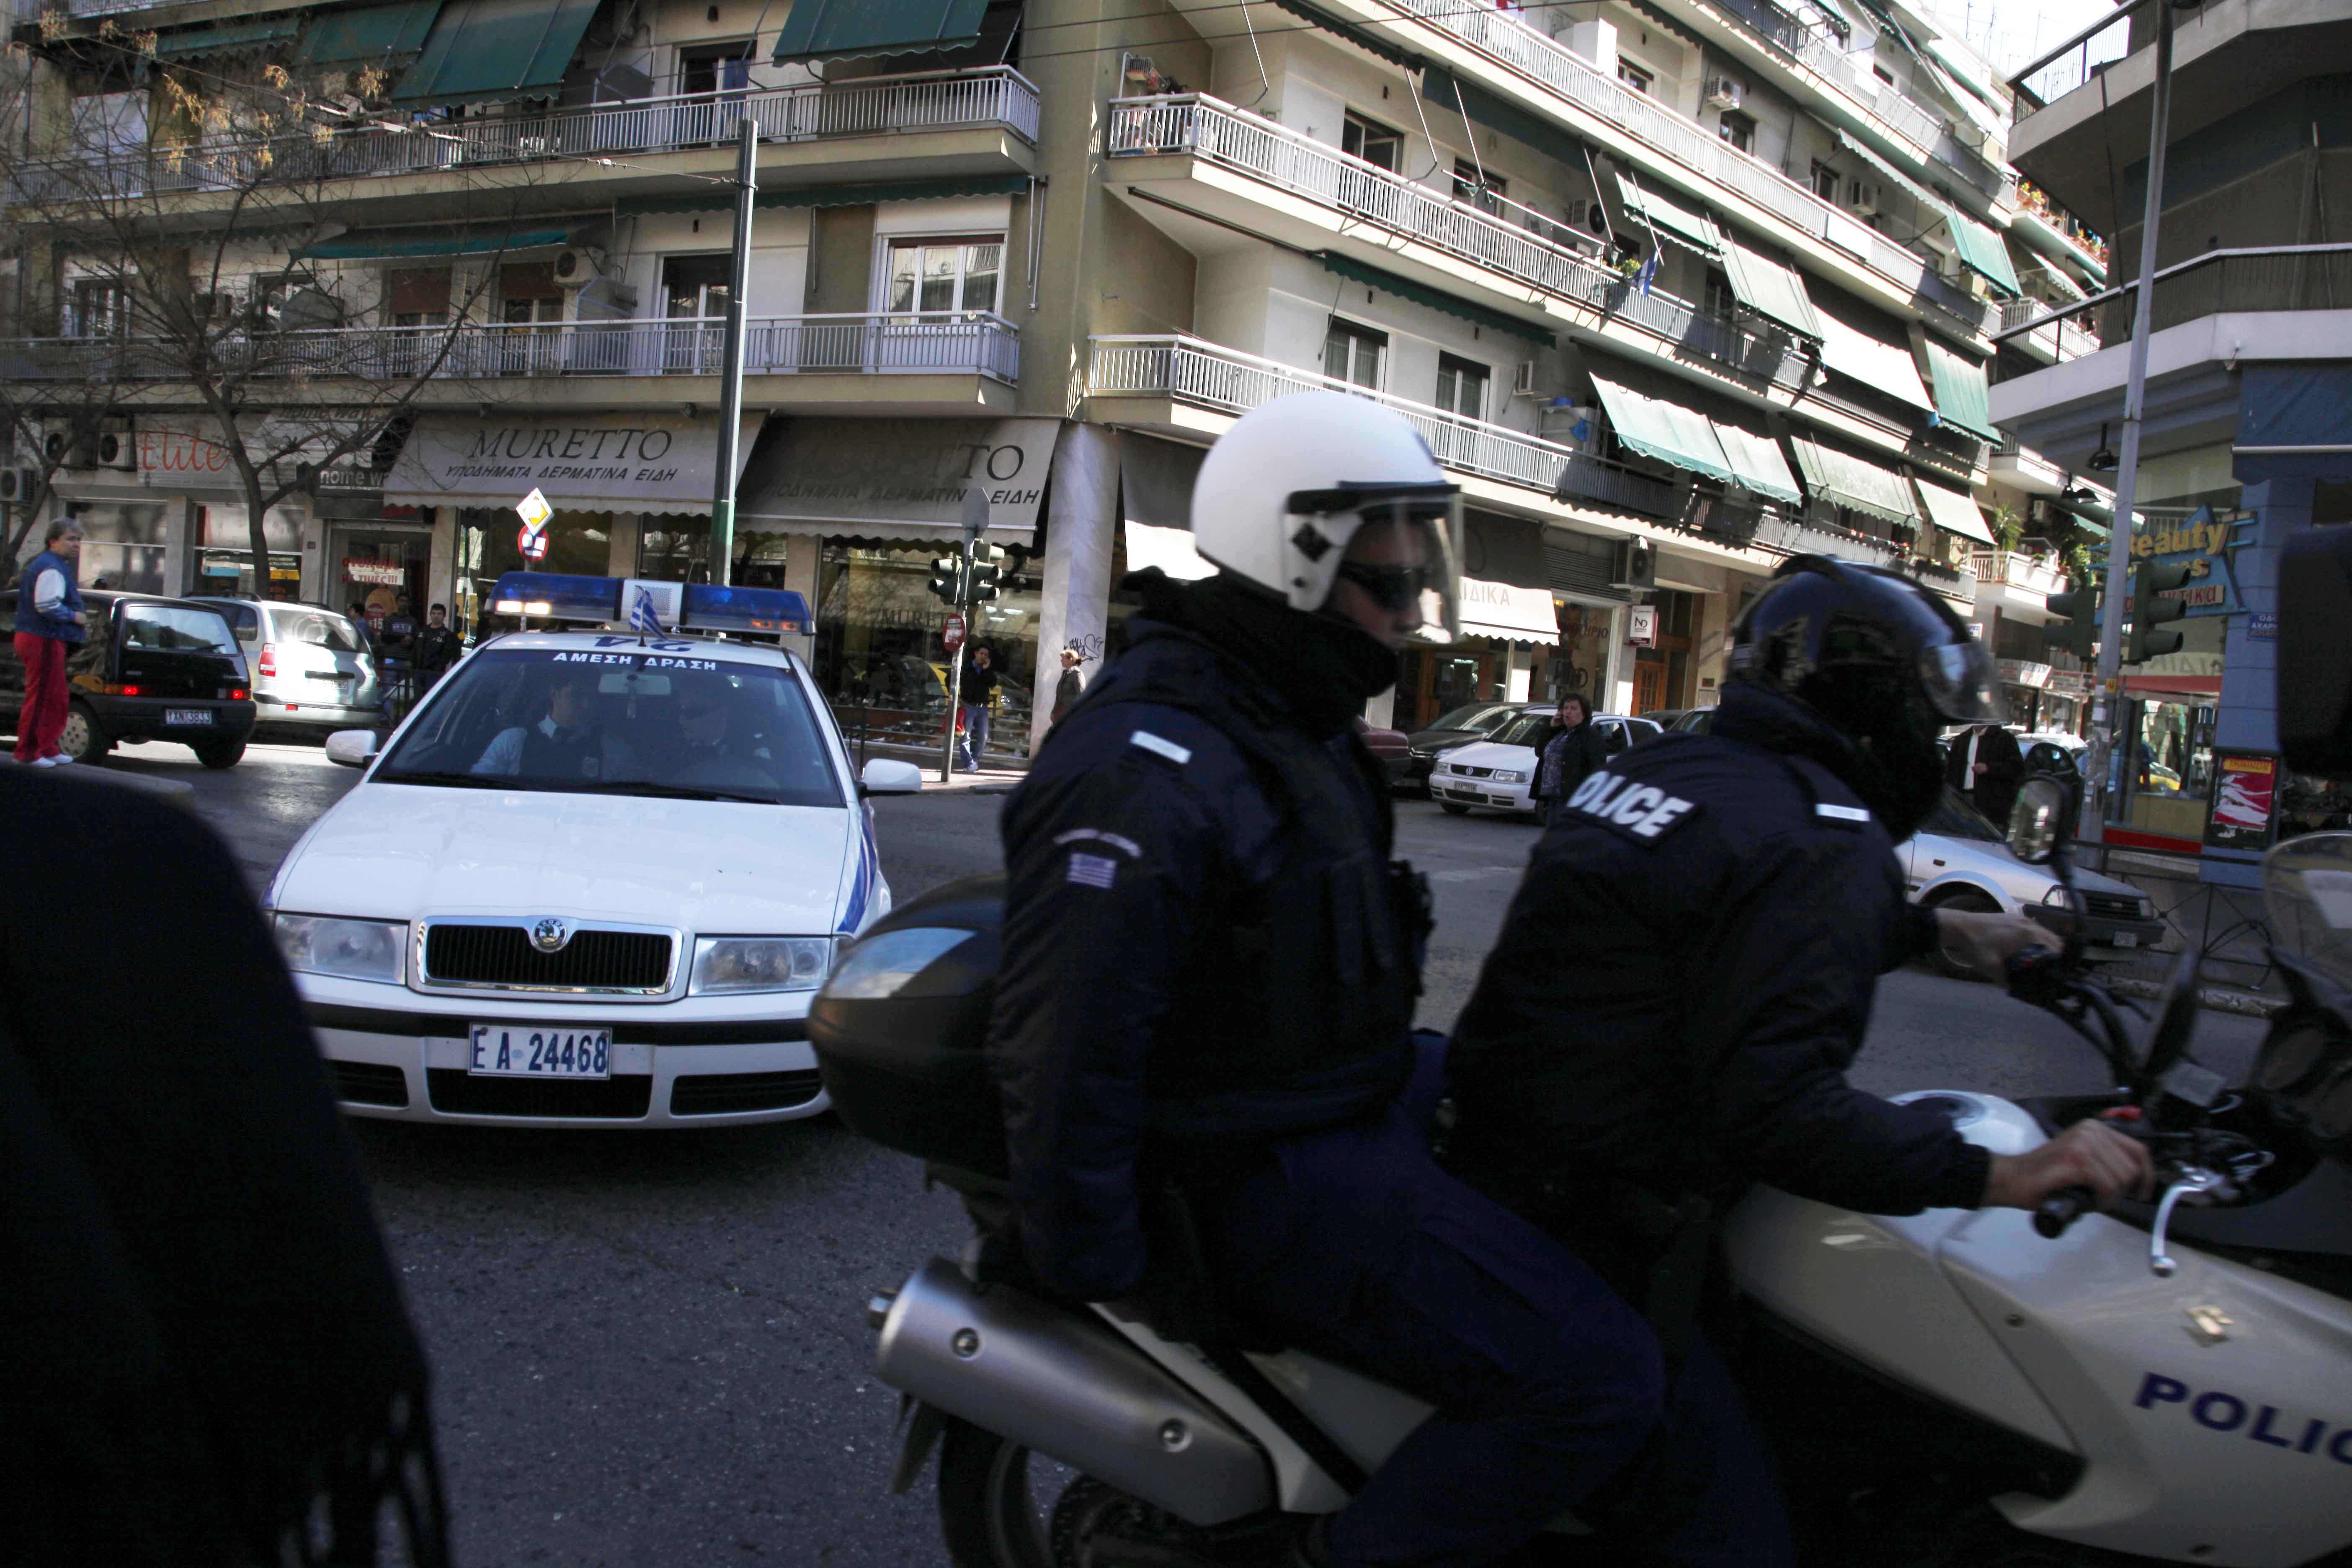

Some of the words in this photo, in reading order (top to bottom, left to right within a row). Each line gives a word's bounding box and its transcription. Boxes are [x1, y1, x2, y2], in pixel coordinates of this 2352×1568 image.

[140, 425, 231, 472] Elite
[467, 428, 672, 461] MURETTO
[446, 466, 531, 478] ΥΠΟΔΗΜΑΤΑ
[538, 466, 628, 480] ΔΕΡΜΑΤΙΝΑ
[635, 469, 678, 481] ΕΙΔΗ
[869, 486, 968, 503] ΔΕΡΜΑΤΙΝ
[990, 489, 1039, 504] ΕΙΔΗ
[553, 652, 632, 665] ΑΜΕΣΗ
[644, 657, 717, 671] ΔΡΑΣΗ
[1566, 770, 1695, 838] OLICE
[528, 1032, 607, 1073] 24468
[2132, 1371, 2352, 1466] POLIC
